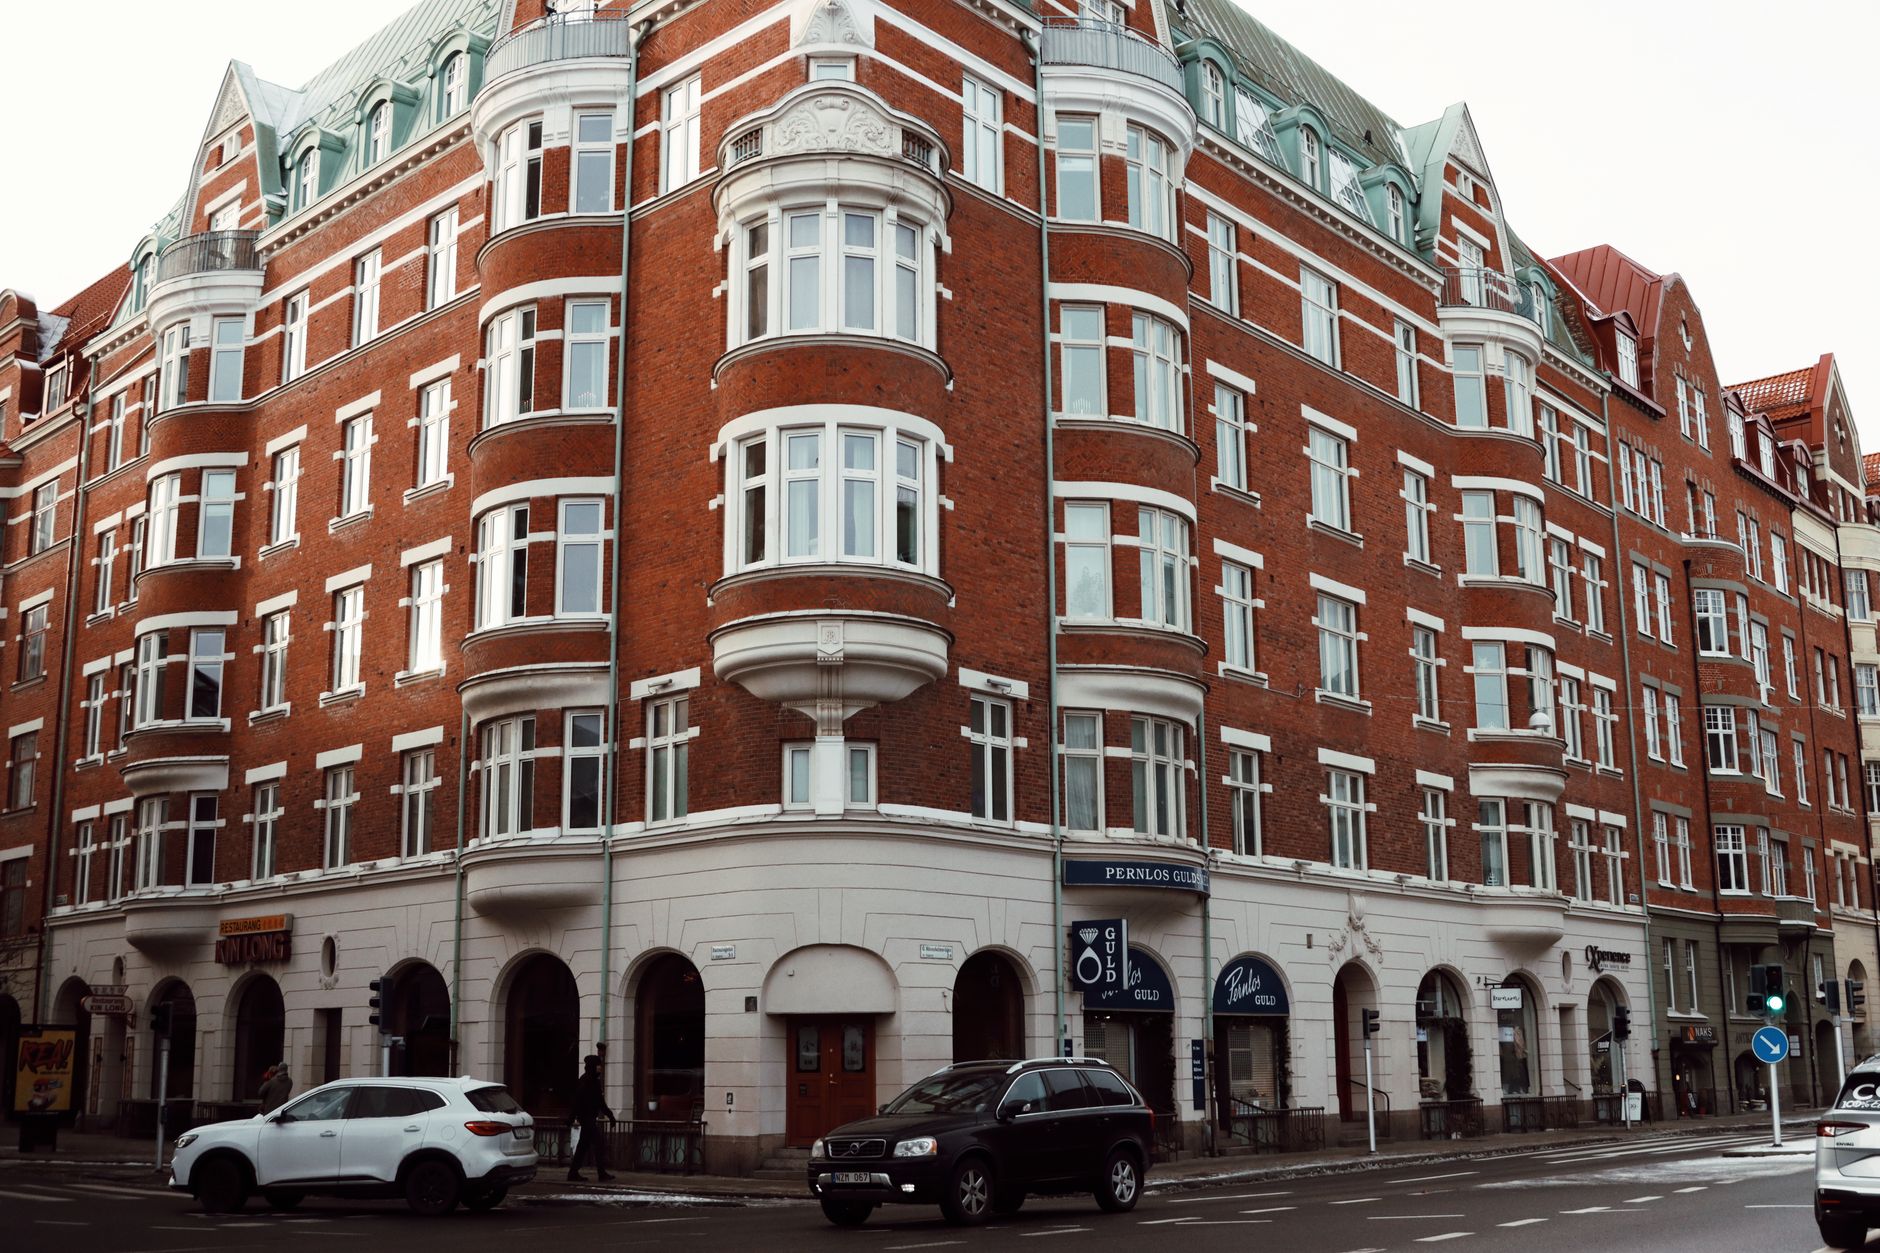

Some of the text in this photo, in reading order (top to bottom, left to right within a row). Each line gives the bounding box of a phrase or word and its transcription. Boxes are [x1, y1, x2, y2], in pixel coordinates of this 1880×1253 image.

[1105, 867, 1170, 881] PERNLOS
[220, 919, 262, 934] RESTAURANG
[217, 933, 285, 964] KIN LONG
[1104, 927, 1117, 983] GULD
[1224, 966, 1261, 1005] Pernlos
[1134, 988, 1159, 1001] GULD
[1255, 994, 1276, 1006] GULD
[1695, 1027, 1712, 1038] NAKS
[1852, 1083, 1880, 1101] C
[836, 1173, 868, 1182] NZM 067
